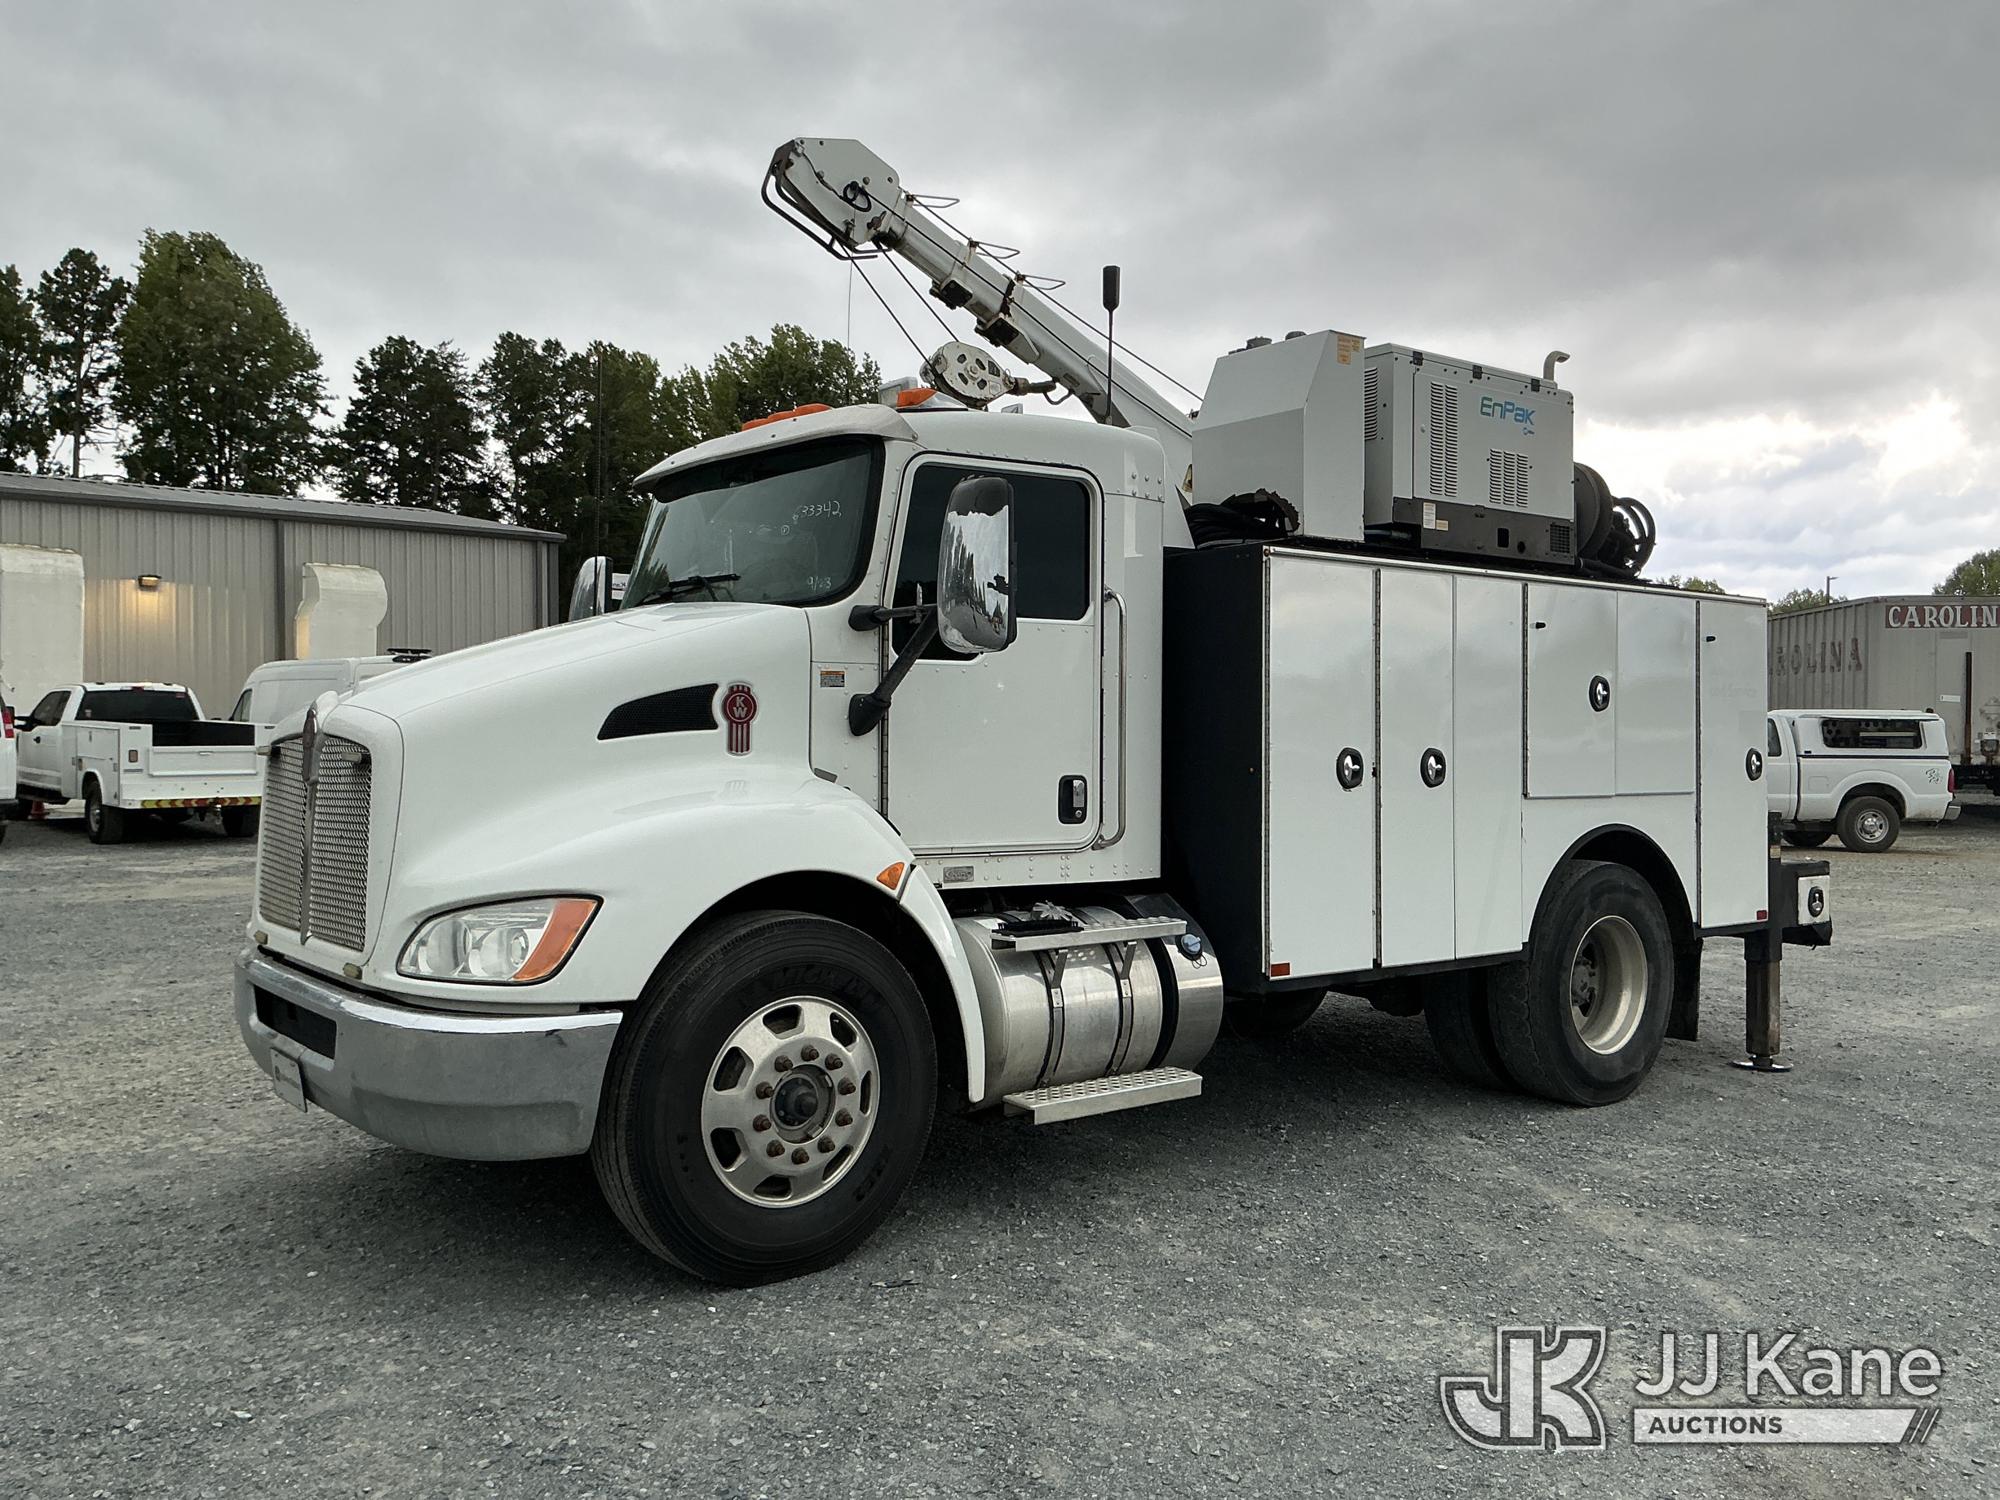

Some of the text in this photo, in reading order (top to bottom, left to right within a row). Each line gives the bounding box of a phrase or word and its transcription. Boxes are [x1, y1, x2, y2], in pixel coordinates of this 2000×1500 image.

[1480, 396, 1536, 425] EnPak
[1888, 605, 1998, 628] CAROLIN
[1769, 637, 1862, 677] ROLINA
